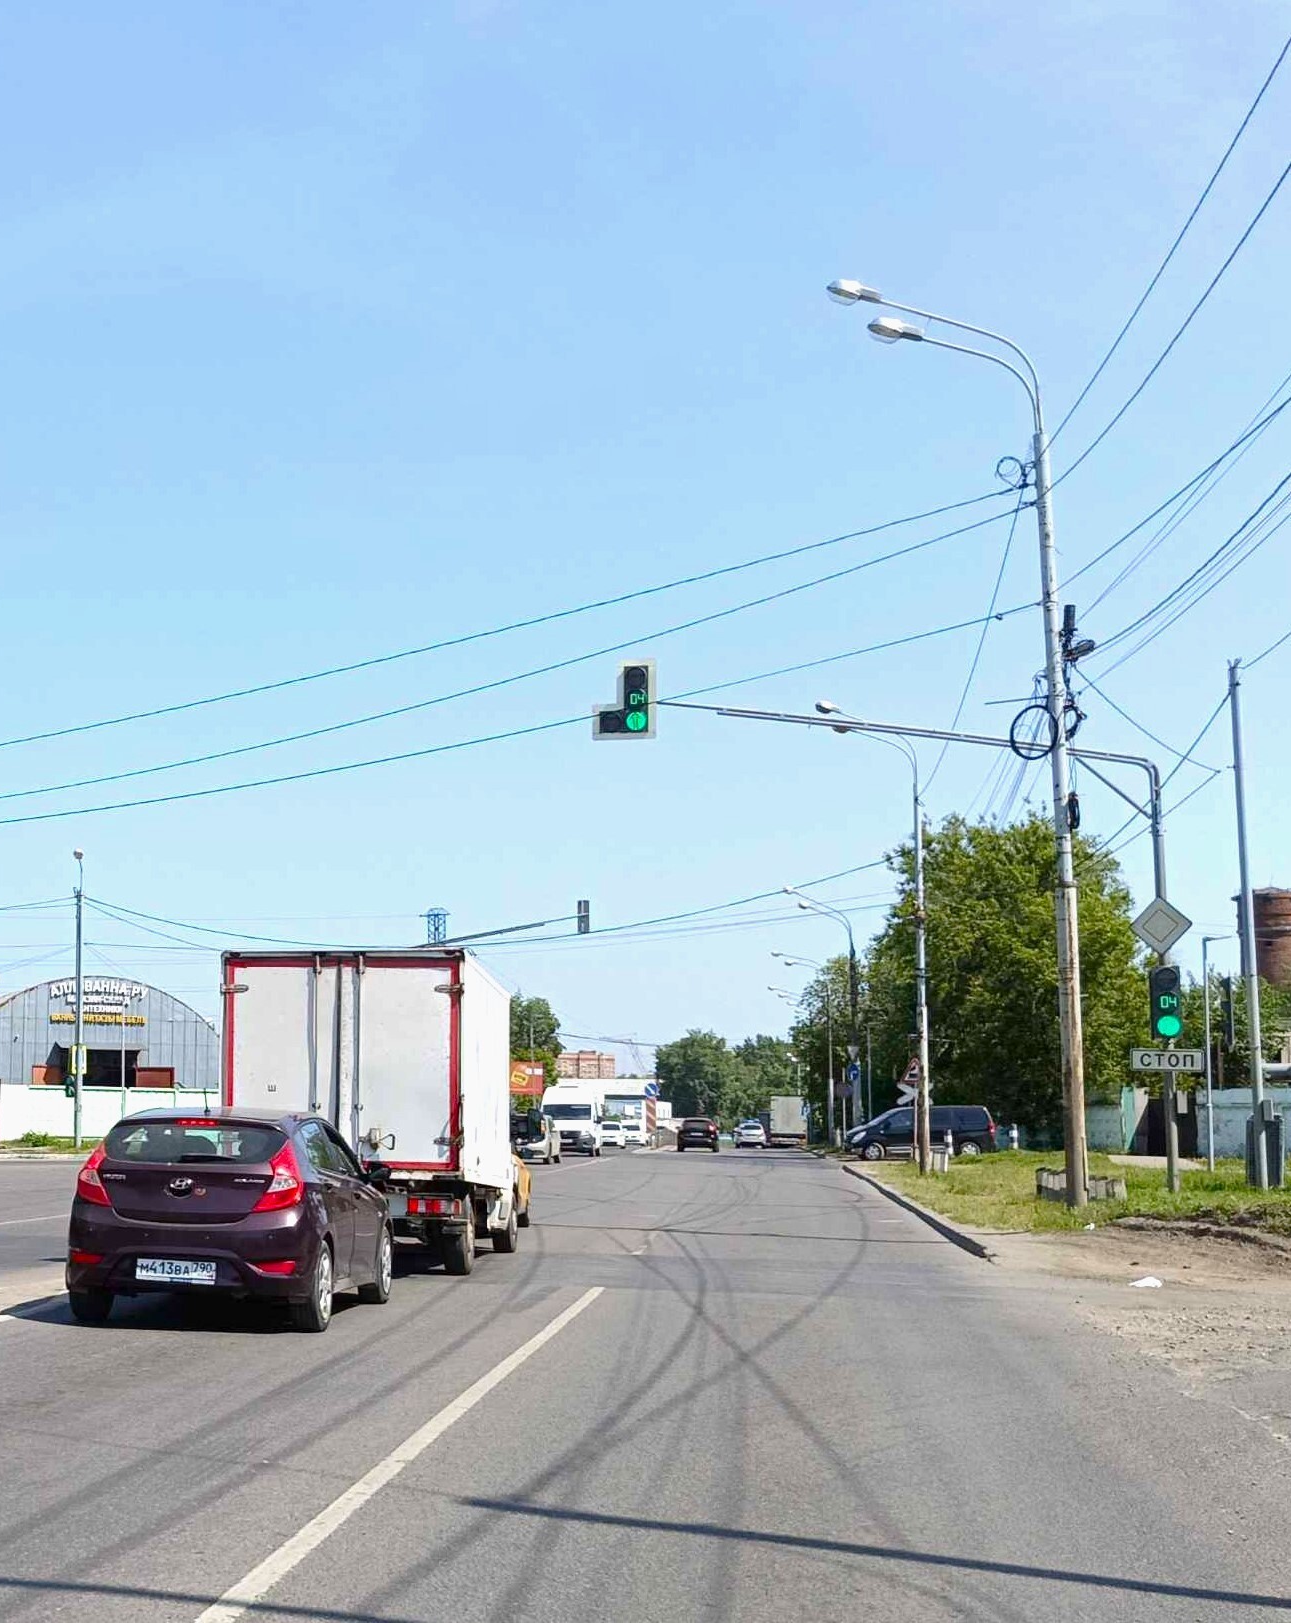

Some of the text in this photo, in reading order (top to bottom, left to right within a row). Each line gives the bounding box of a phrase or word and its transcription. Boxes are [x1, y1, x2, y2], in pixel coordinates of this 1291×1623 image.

[630, 693, 645, 705] 04
[1161, 995, 1178, 1008] 04
[1140, 1053, 1195, 1068] СТОП
[191, 1262, 213, 1272] 790
